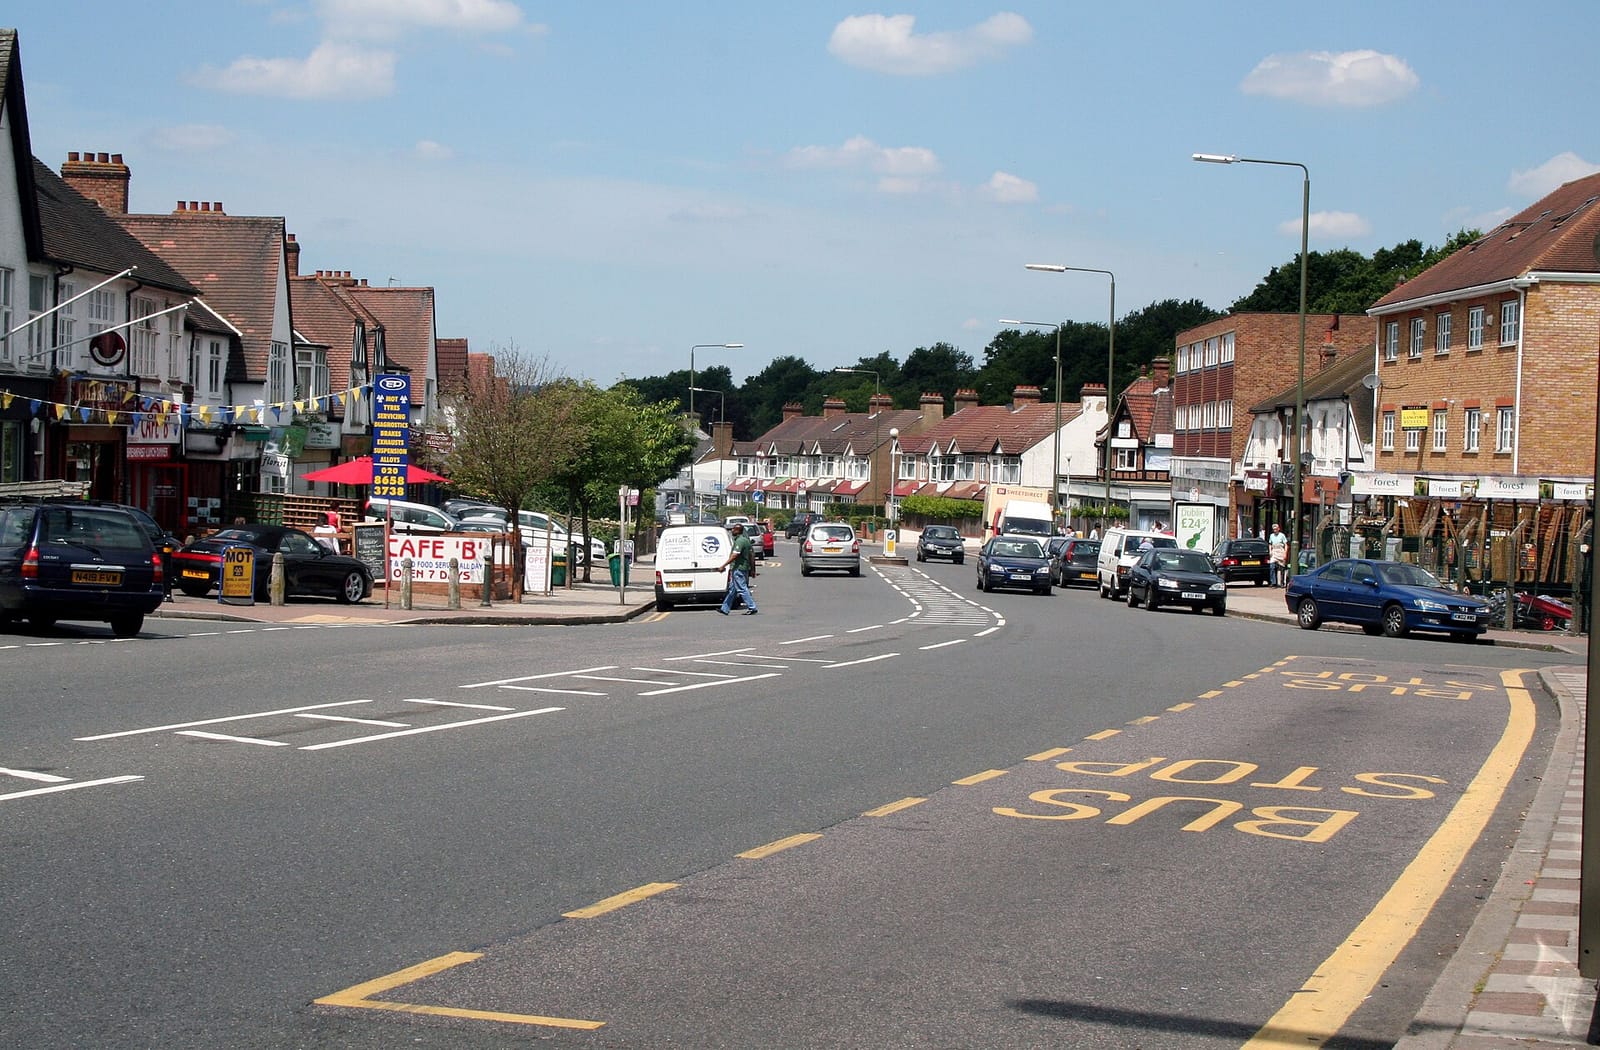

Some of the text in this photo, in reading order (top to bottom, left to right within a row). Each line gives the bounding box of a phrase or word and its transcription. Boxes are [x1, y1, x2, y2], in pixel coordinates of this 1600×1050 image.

[377, 412, 406, 420] SERVICING
[373, 447, 408, 455] SUSPENSION
[262, 456, 287, 467] florist
[381, 467, 399, 475] 020
[374, 475, 405, 486] 8658
[1373, 477, 1399, 487] forest
[1498, 480, 1524, 490] forest
[373, 486, 405, 496] 3738
[1562, 487, 1583, 495] forest
[1181, 507, 1205, 517] Dublin
[388, 539, 445, 559] CAFE
[226, 551, 252, 563] MOT
[528, 556, 546, 564] OPE
[417, 560, 434, 568] FOOD
[459, 562, 470, 570] ALL
[471, 562, 483, 570] DAY
[393, 568, 424, 578] OEN
[429, 570, 435, 579] 7
[1280, 671, 1498, 691] STOP
[1282, 679, 1473, 701] BUS
[1055, 756, 1448, 800] STOP
[992, 788, 1360, 844] BUS
